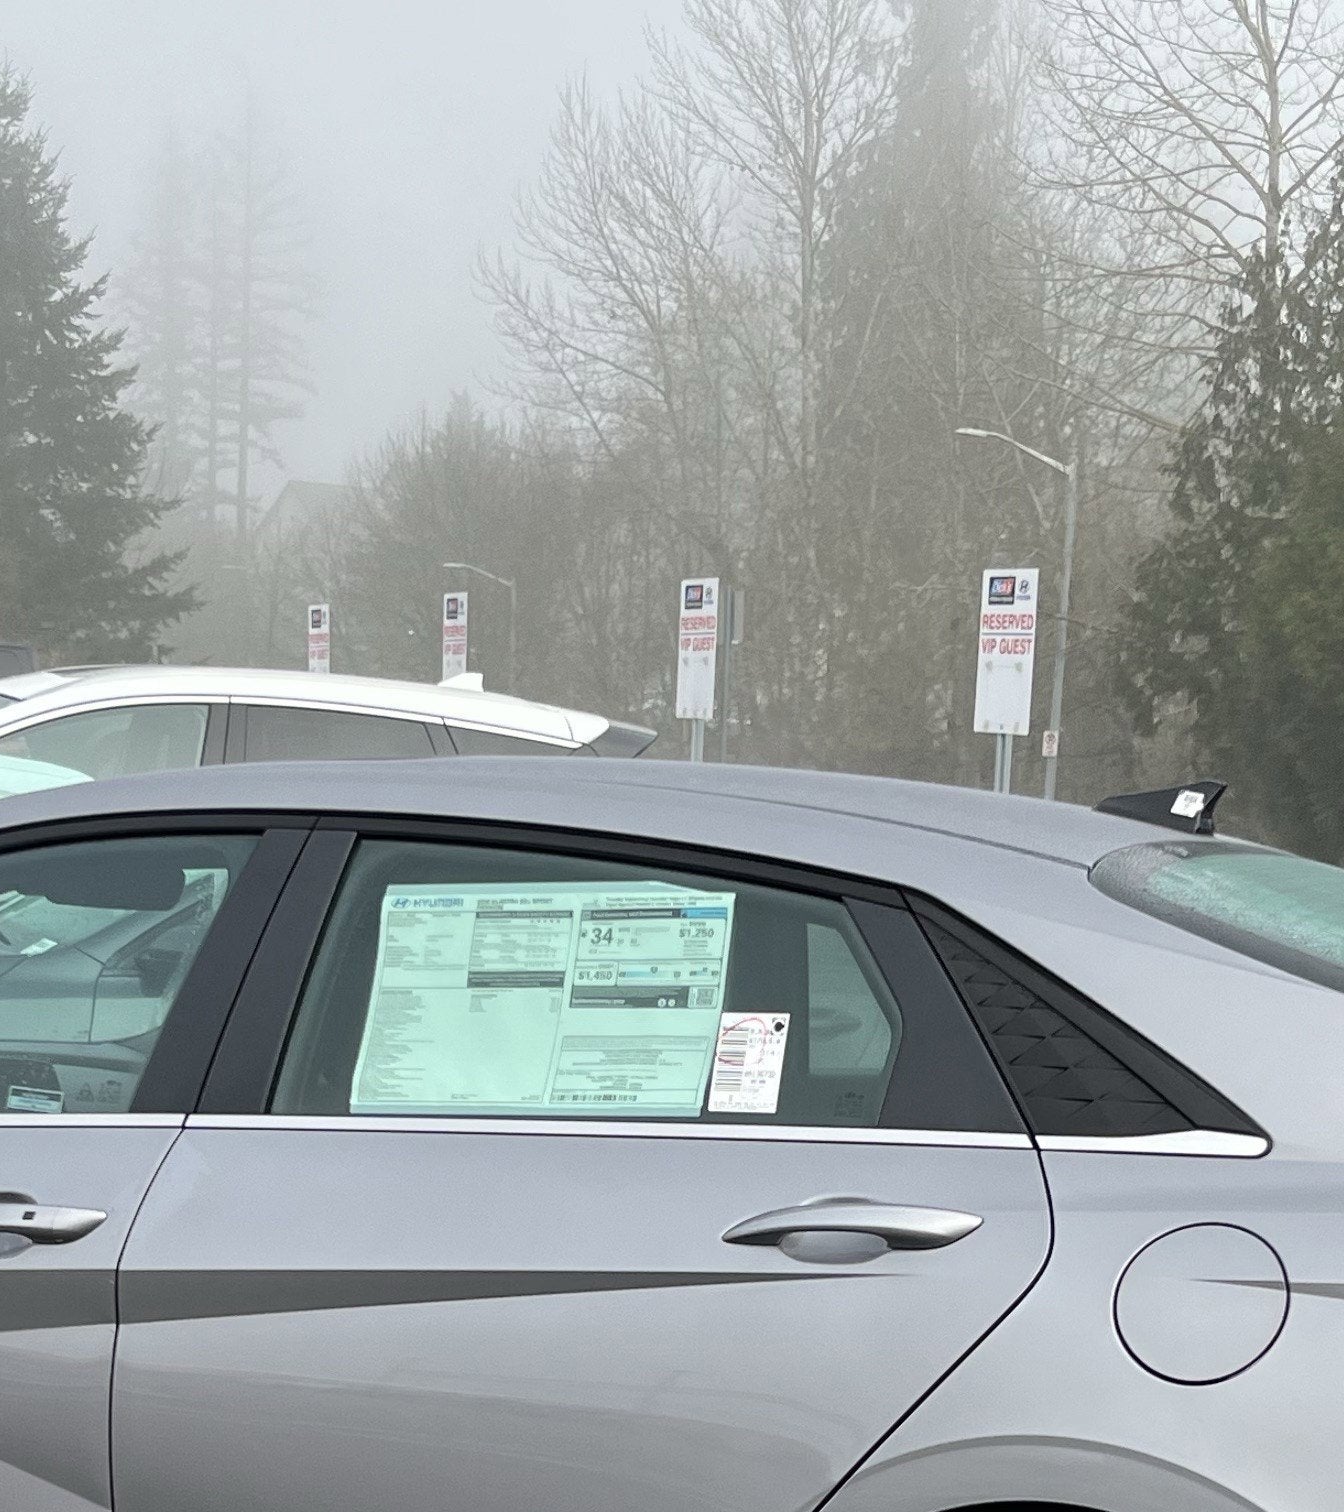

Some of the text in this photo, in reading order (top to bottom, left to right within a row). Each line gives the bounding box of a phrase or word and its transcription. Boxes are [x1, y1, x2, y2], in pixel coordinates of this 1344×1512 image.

[982, 614, 1034, 630] RESERVED
[981, 637, 1032, 655] VIP GUEST
[591, 927, 614, 945] 34
